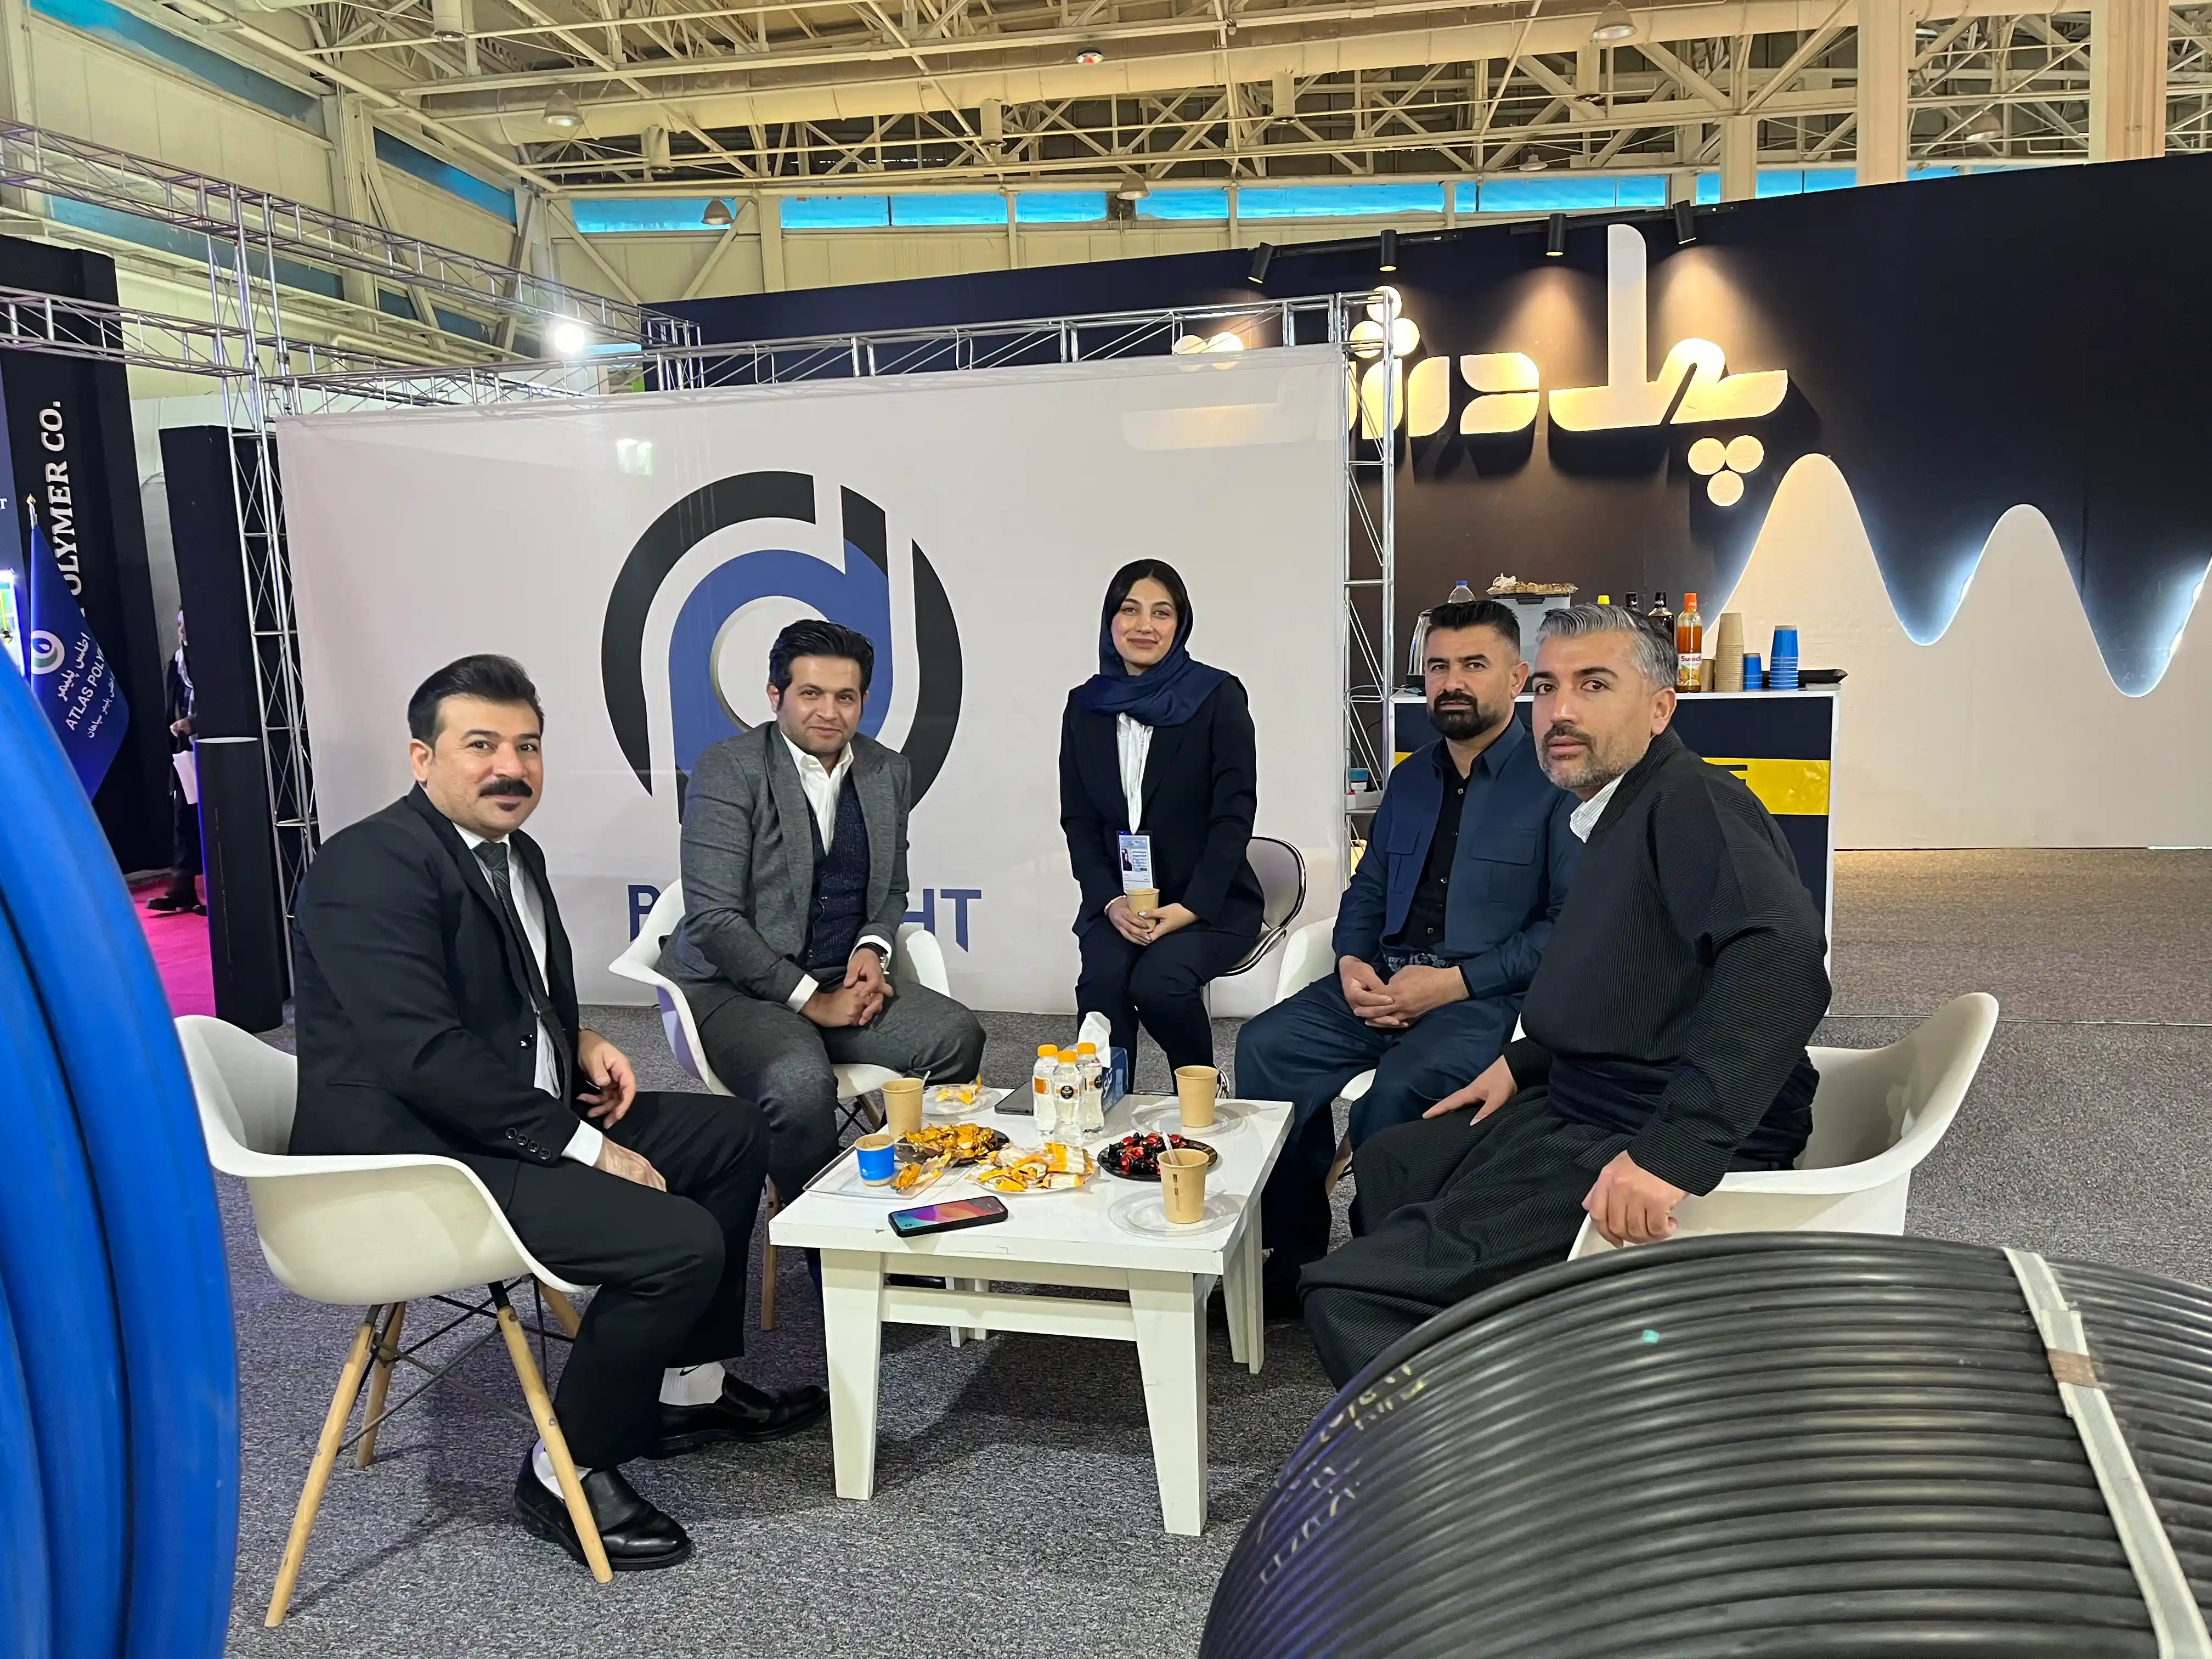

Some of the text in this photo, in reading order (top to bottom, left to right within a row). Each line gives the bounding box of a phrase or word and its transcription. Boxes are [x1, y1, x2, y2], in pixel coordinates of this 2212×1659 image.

[39, 401, 86, 617] OLYMER CO.
[58, 632, 90, 702] اطلس پلیمر
[66, 642, 105, 730] ATLAS POLY
